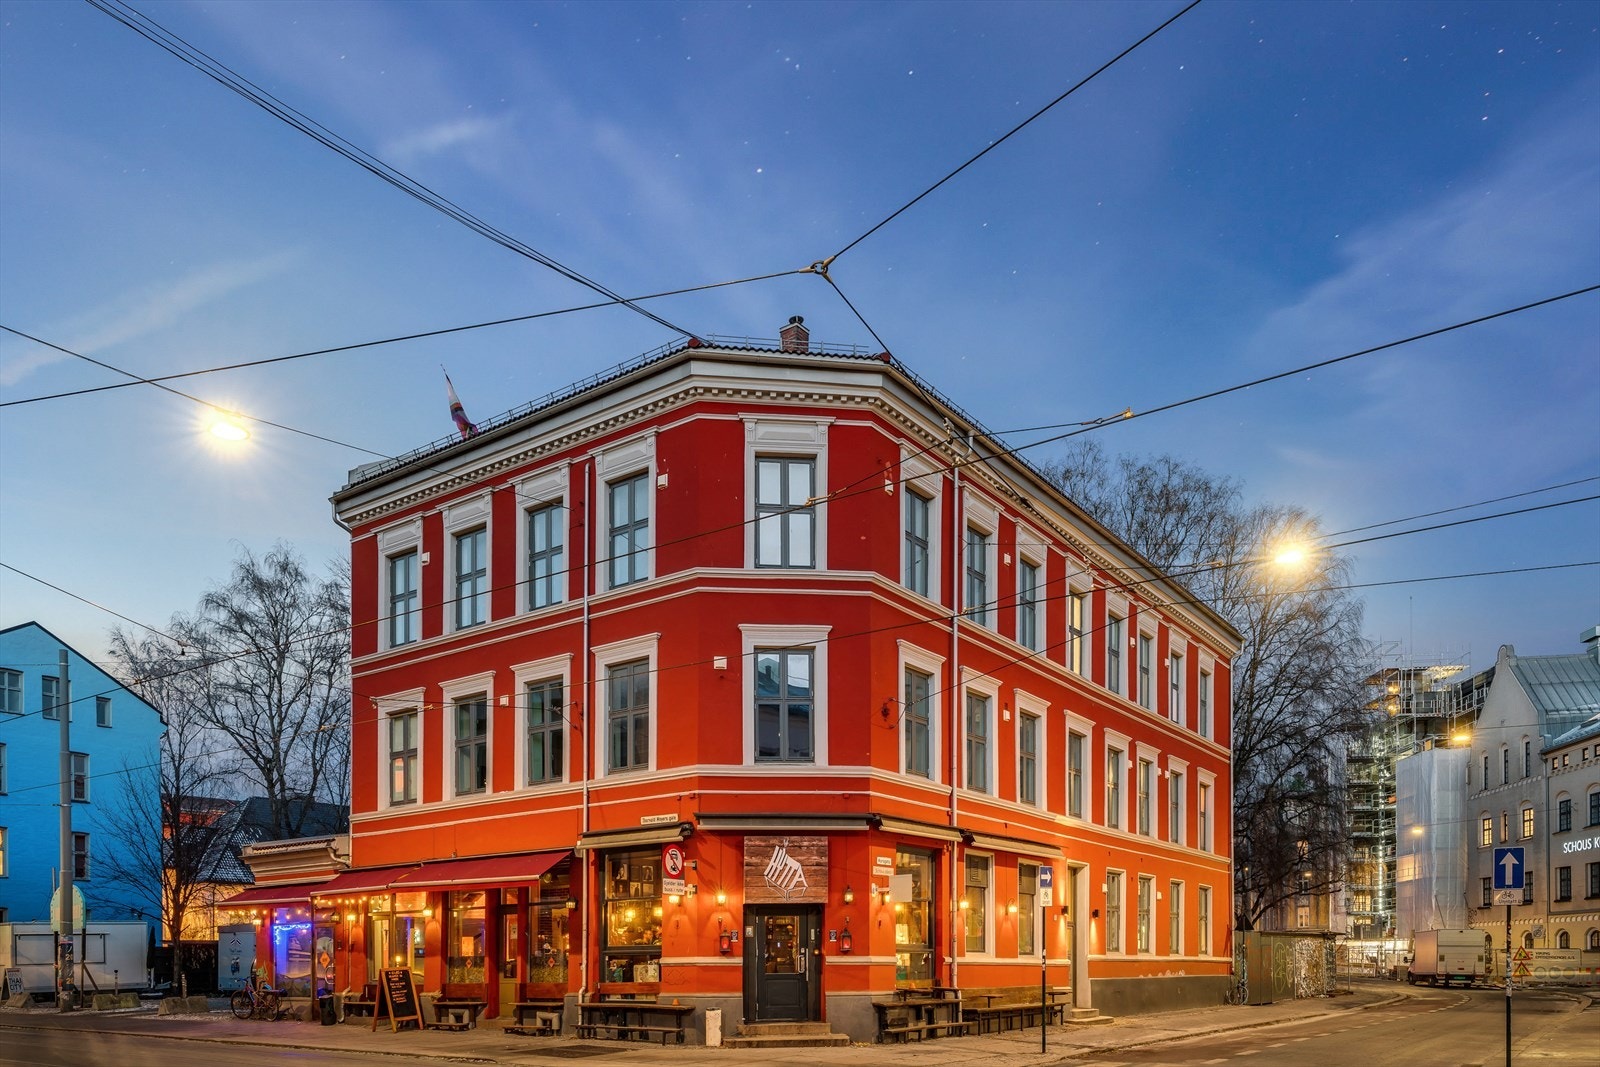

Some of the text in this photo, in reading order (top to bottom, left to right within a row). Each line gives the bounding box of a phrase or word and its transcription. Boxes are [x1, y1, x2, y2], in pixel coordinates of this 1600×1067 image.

[1563, 836, 1600, 854] SCHOUS K
[763, 845, 808, 890] HYTTA
